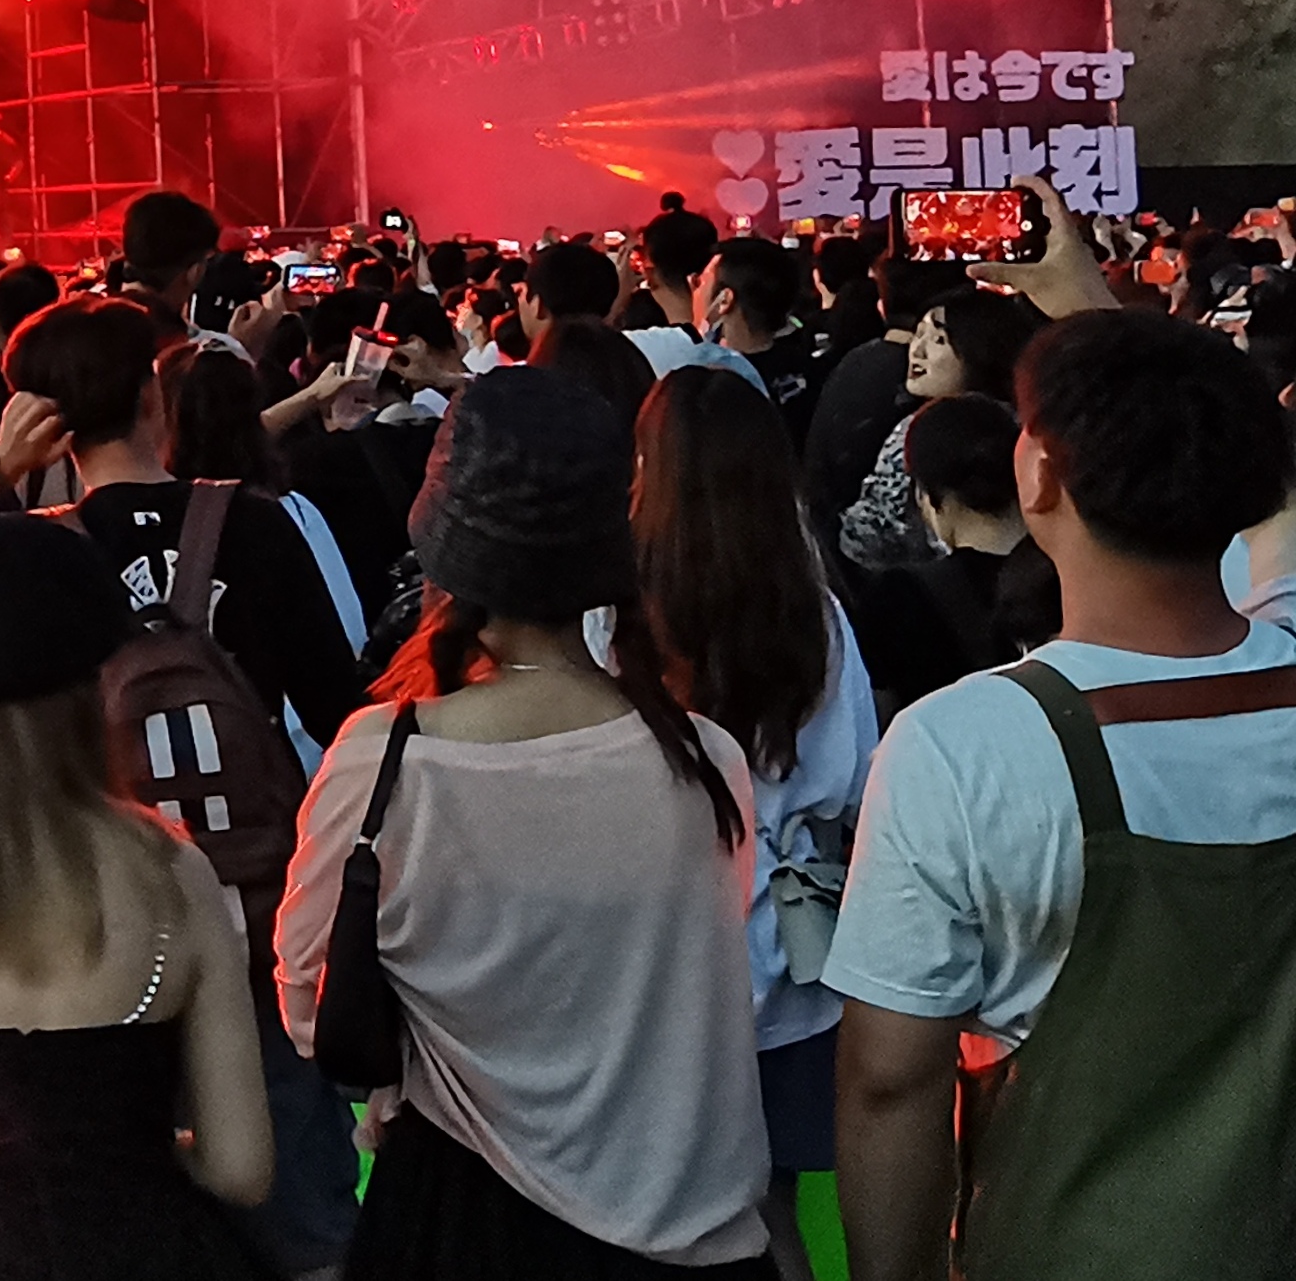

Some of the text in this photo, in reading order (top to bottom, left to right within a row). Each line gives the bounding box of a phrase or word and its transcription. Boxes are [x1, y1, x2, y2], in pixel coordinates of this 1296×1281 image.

[880, 50, 1135, 102] 愛は今です
